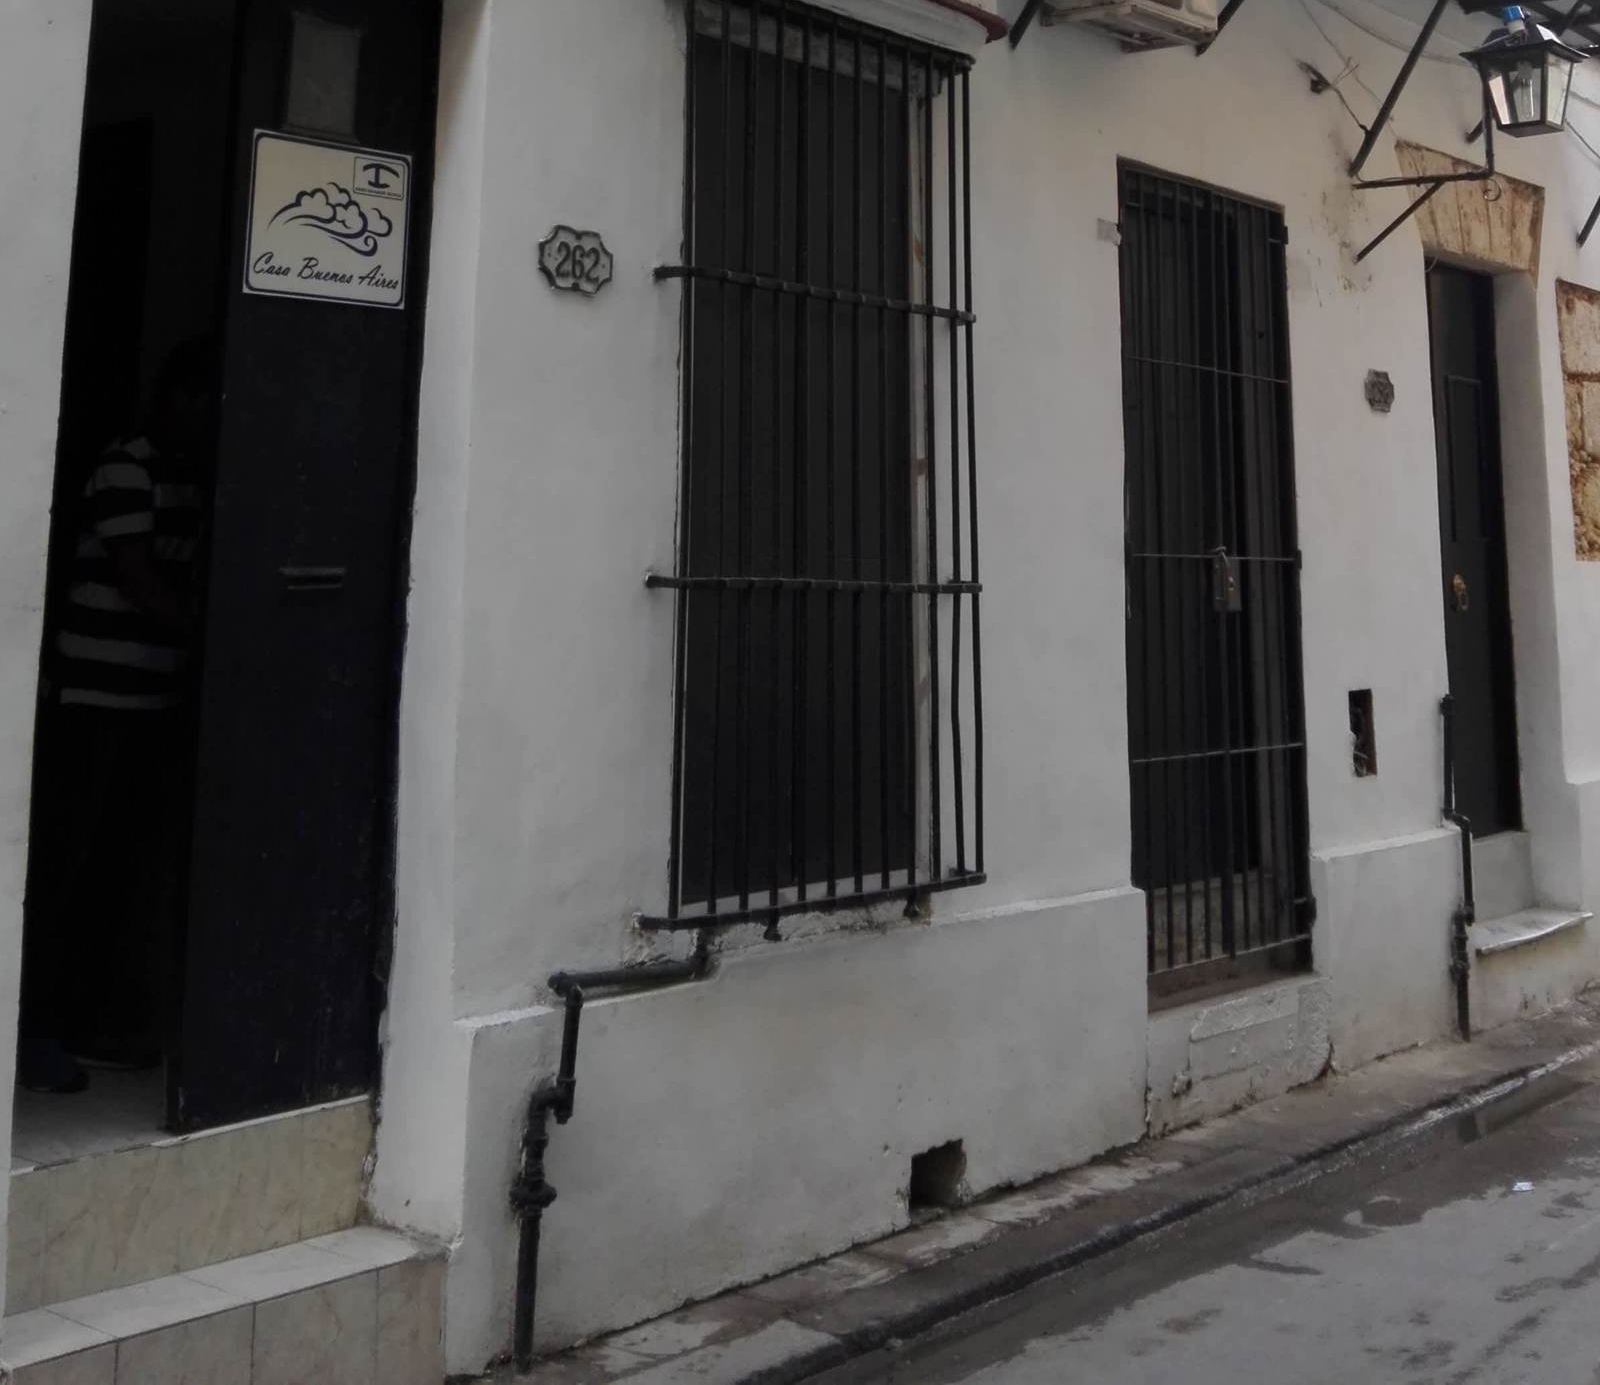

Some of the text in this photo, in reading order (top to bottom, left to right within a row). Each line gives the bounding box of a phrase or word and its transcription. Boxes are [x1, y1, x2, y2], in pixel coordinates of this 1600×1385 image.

[253, 251, 399, 289] Casa Buenos Aires
[555, 241, 600, 282] 262
